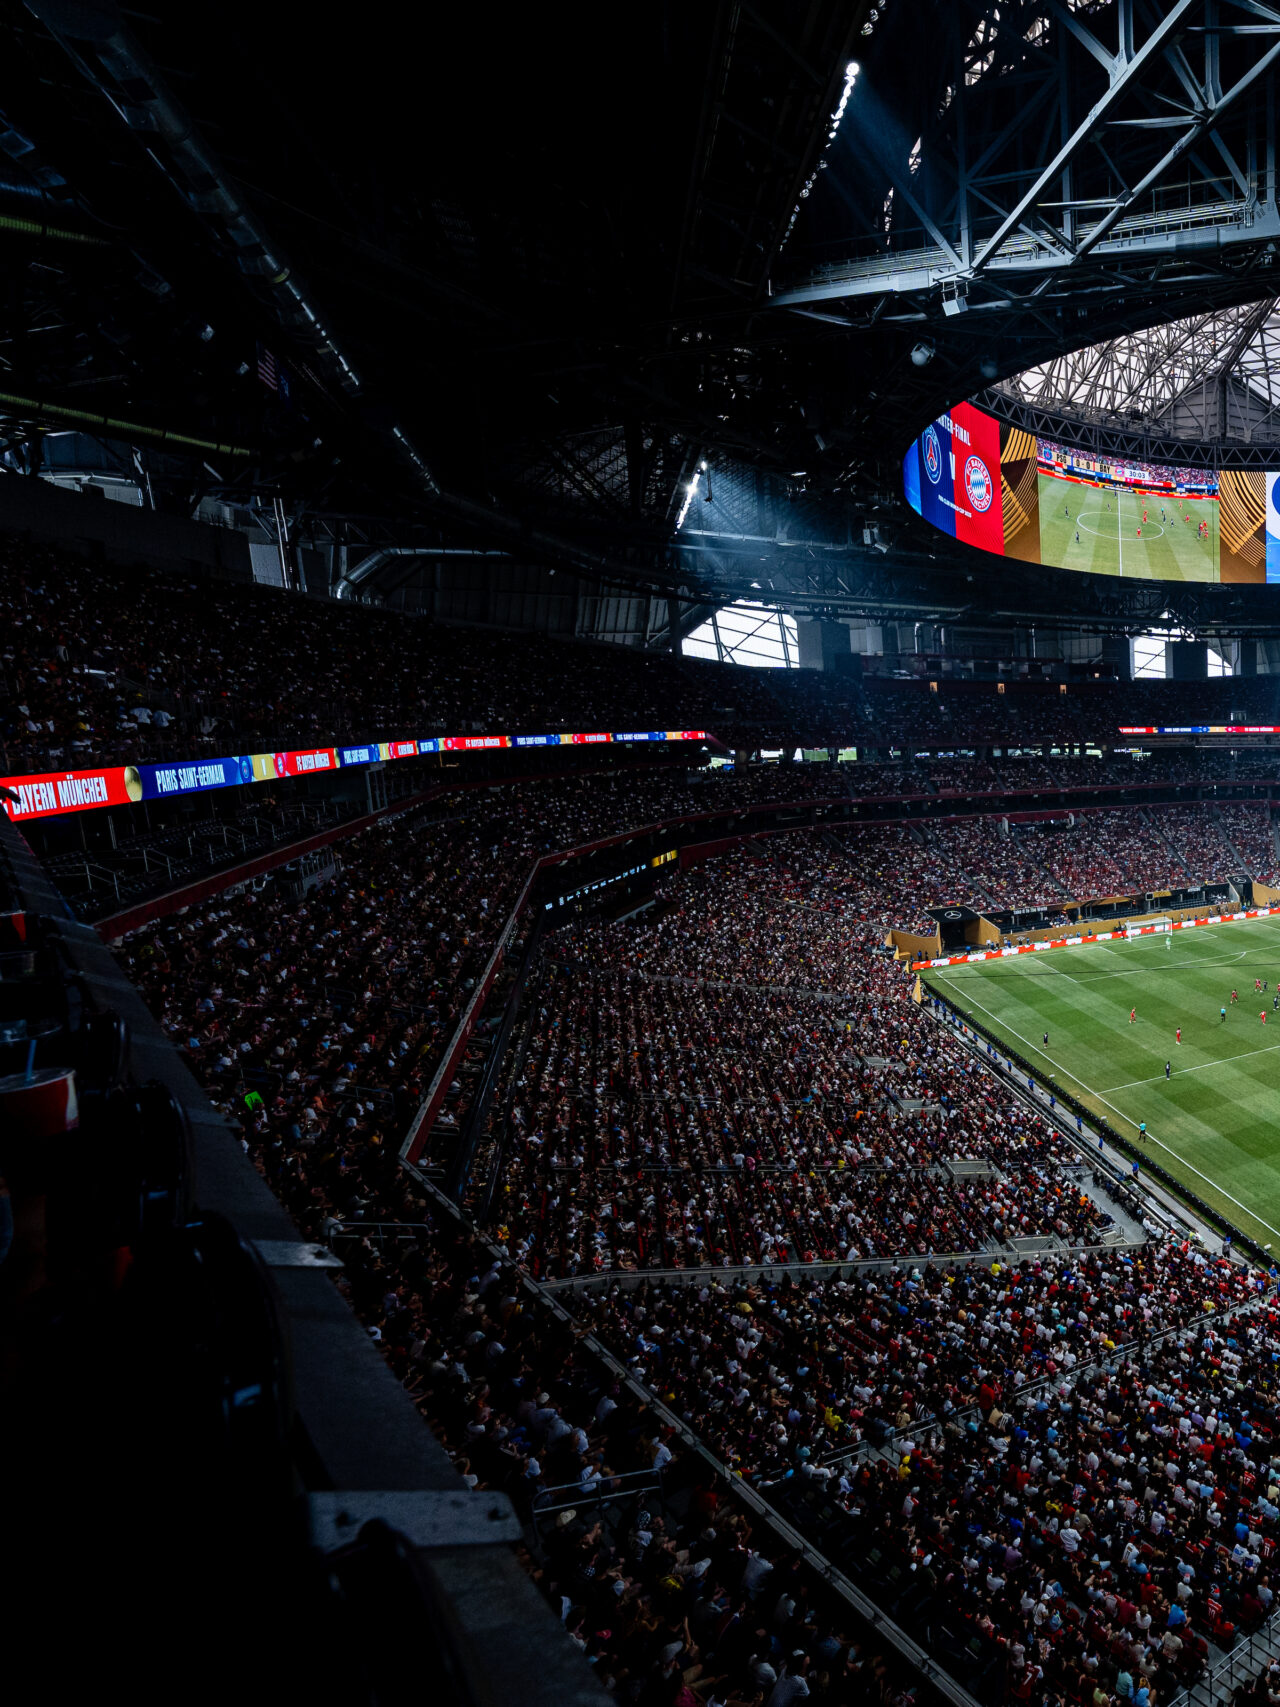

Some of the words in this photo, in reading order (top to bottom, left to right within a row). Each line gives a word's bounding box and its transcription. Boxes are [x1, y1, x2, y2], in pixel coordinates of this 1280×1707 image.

[1056, 453, 1067, 464] PSG
[1099, 464, 1110, 474] BAY
[155, 769, 178, 793] PARIS
[178, 764, 226, 790] SAINT-GERMAIN
[9, 781, 57, 815] BAYERN
[57, 774, 109, 808] MÜNCHEN
[1023, 1671, 1033, 1687] 7
